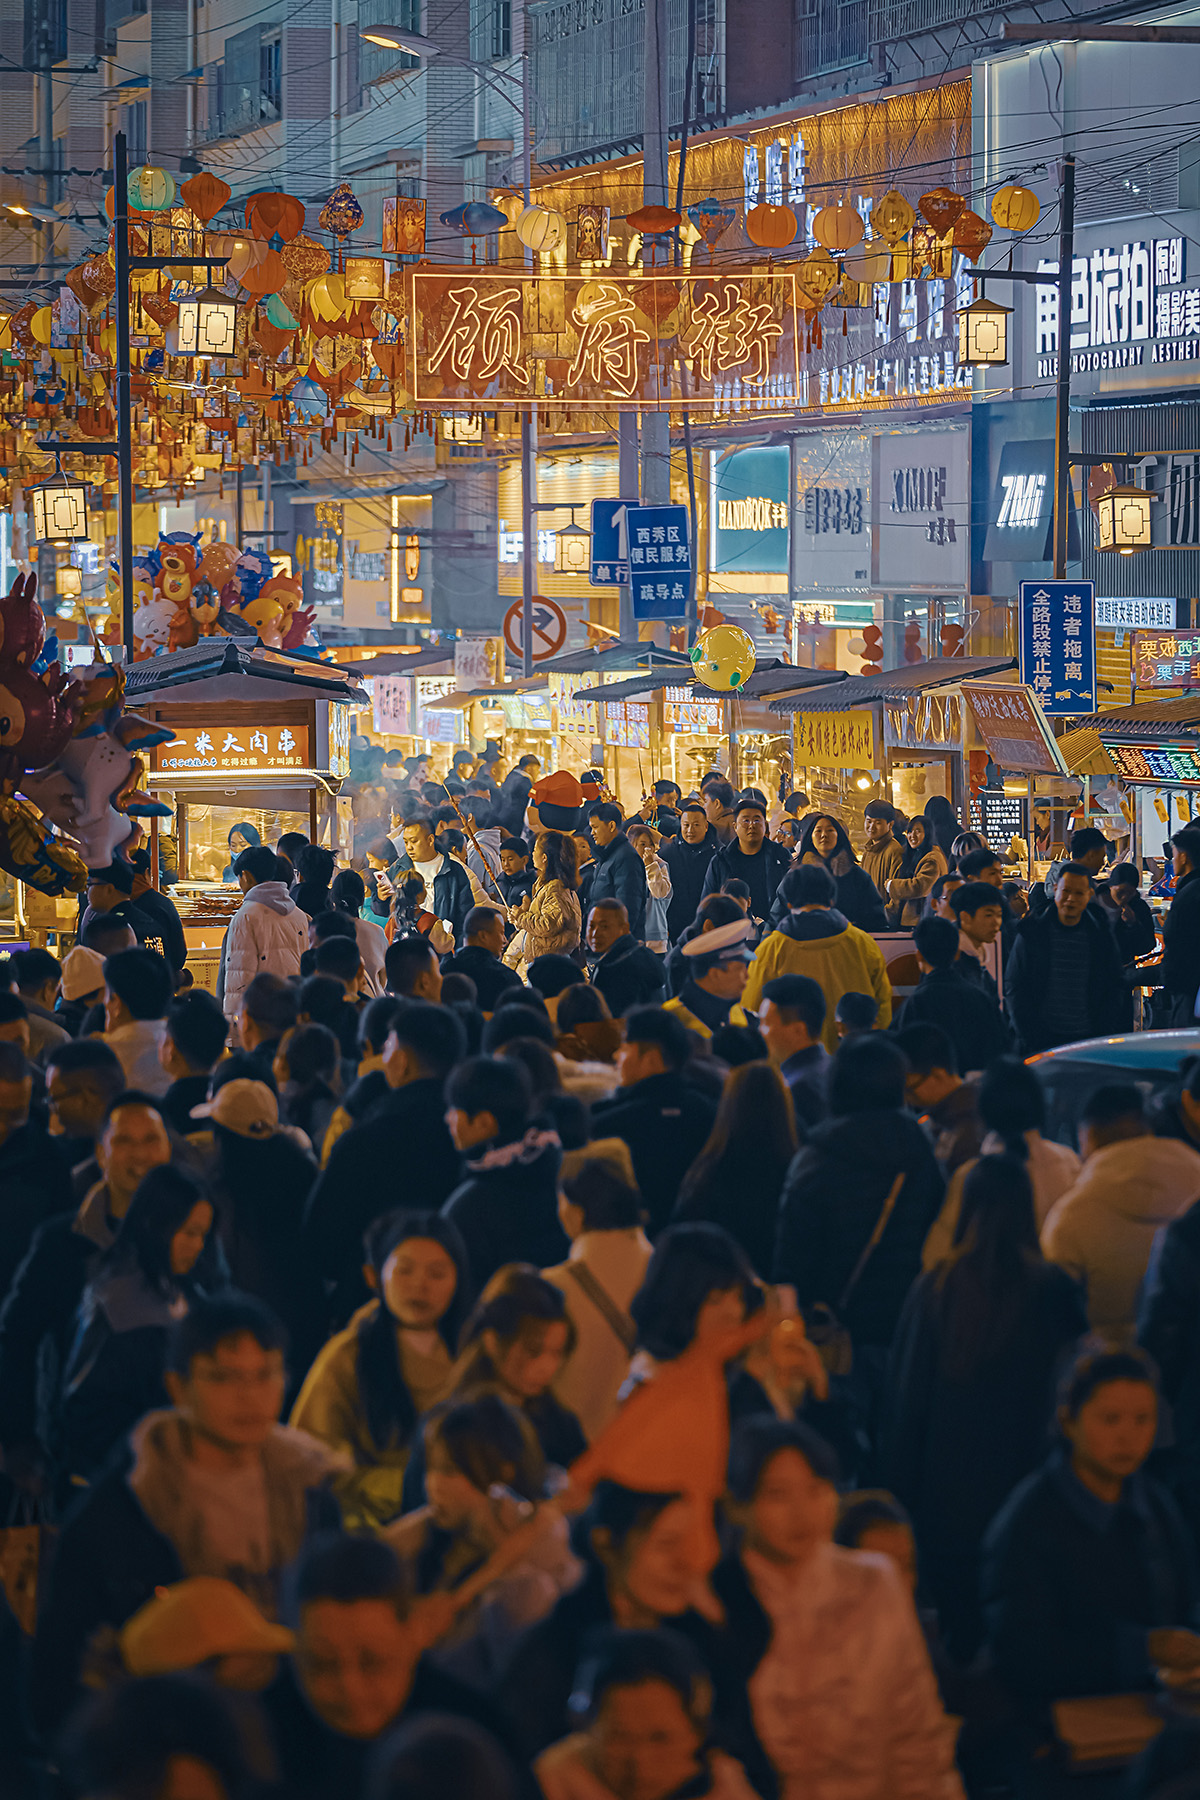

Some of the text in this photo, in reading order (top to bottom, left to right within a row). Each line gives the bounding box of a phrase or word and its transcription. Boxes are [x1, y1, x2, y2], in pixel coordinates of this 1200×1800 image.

[1155, 237, 1182, 286] 原创
[1036, 241, 1149, 354] 角色旅拍
[428, 284, 784, 395] 顾府街
[1037, 339, 1200, 378] ROLE HOTOGRAPHY AESTHET
[718, 496, 772, 531] HANDBOOK
[636, 525, 681, 544] 西秀区
[631, 545, 690, 564] 便民服务
[640, 583, 685, 600] 疏导点
[1032, 589, 1053, 709] 全路段禁止停车
[1063, 594, 1083, 681] 违者拖离
[165, 728, 297, 756] 一米大肉串
[221, 757, 258, 766] 吃得过瘾
[267, 757, 304, 766] 才叫满足
